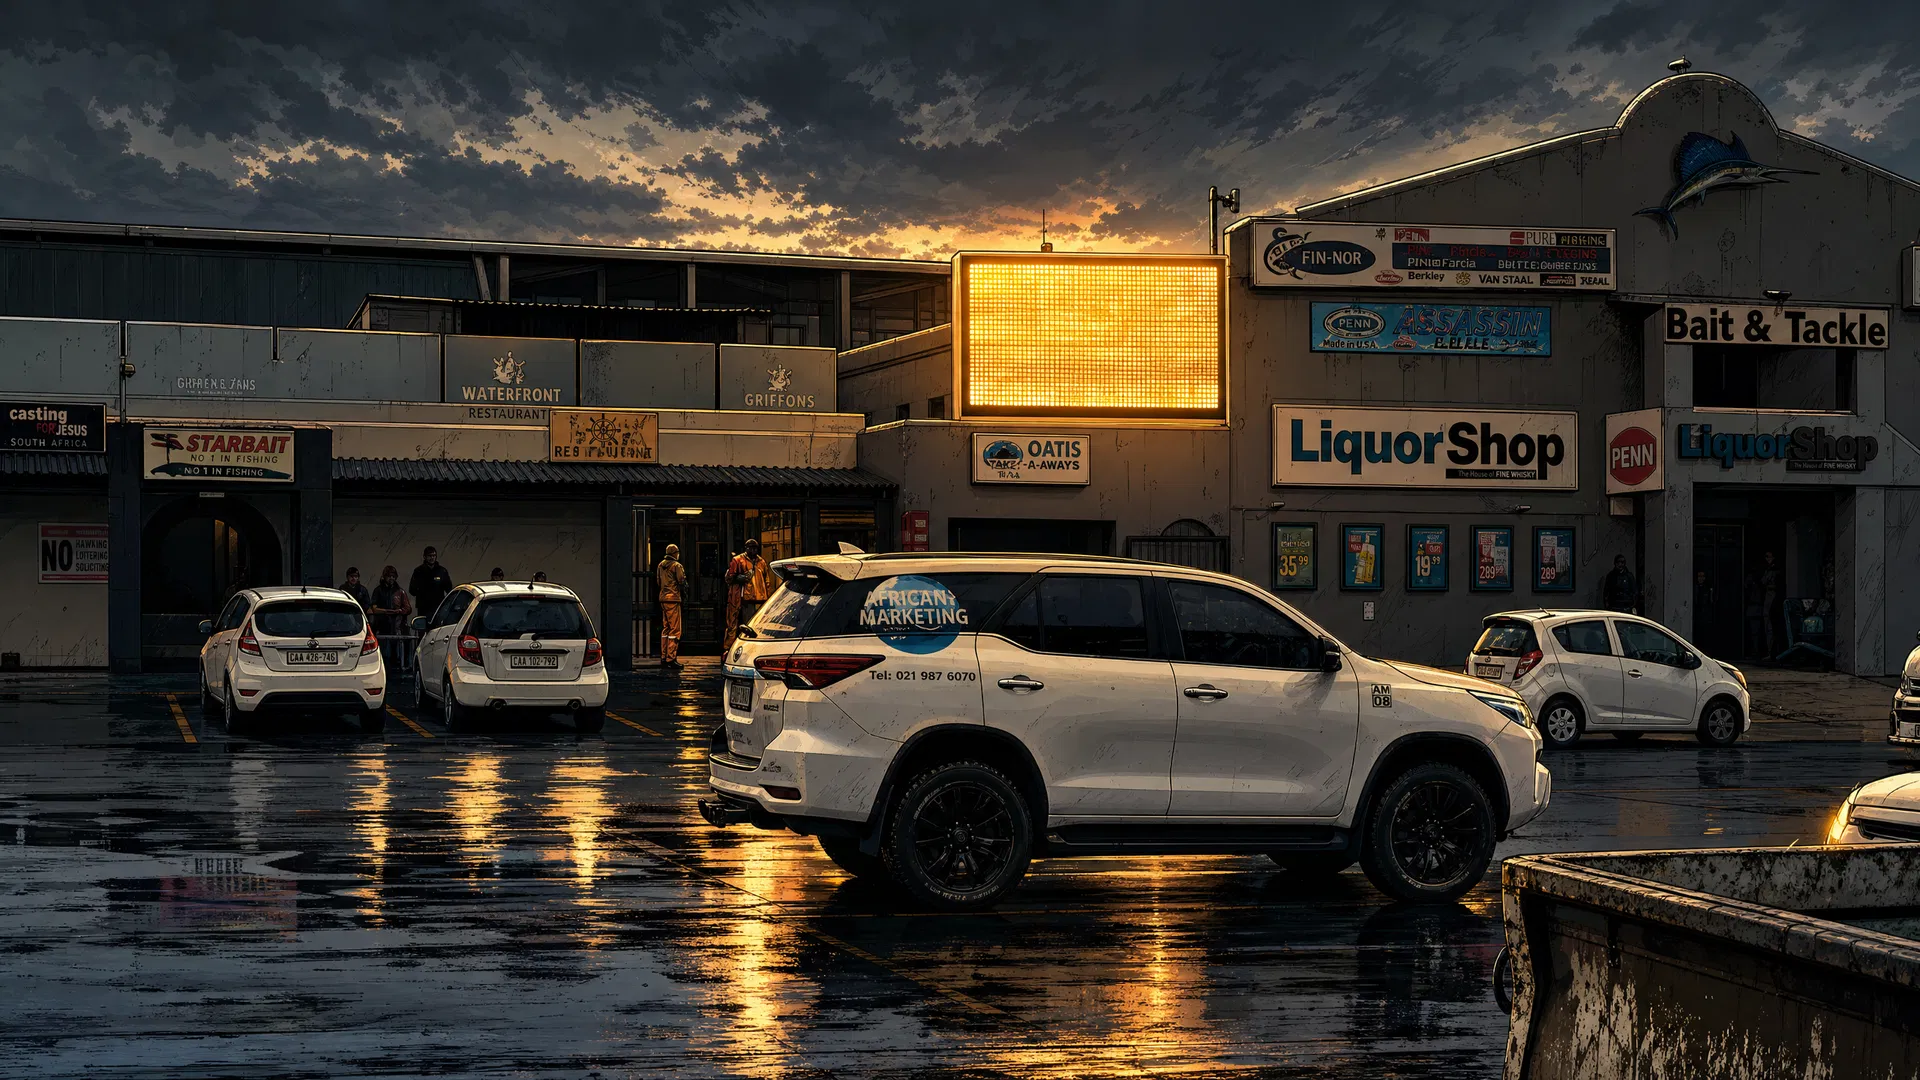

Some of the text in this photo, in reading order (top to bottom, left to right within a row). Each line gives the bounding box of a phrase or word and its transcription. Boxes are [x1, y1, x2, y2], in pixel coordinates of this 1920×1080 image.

[1526, 232, 1556, 245] PURE
[1302, 250, 1362, 265] FIN-NOR
[1408, 271, 1445, 282] Berkley
[1478, 274, 1500, 284] VAN
[1502, 275, 1534, 285] STAAL
[1339, 318, 1371, 329] PENN
[1393, 307, 1543, 337] ASSASSIN
[1667, 307, 1886, 346] Bait & Tackle
[1323, 339, 1345, 348] Made
[1347, 340, 1355, 348] in
[462, 386, 562, 402] WATERFRONT
[744, 393, 816, 408] GRIFFONS
[9, 406, 68, 424] casting
[469, 408, 547, 420] RESTAURANT
[36, 423, 88, 437] FOR JESUS
[10, 437, 88, 448] SOUTH AFRICA
[187, 434, 291, 453] STARBAIT
[1028, 440, 1081, 458] OATIS
[190, 454, 279, 464] NO 1 IN FISHING
[1611, 443, 1654, 470] PENN
[184, 466, 264, 476] NO 1 IN FISHING
[1458, 470, 1469, 478] The
[1496, 470, 1510, 478] FINE
[1511, 470, 1535, 479] WHISKY
[41, 539, 73, 572] NO
[1279, 555, 1309, 577] 35 99
[1415, 555, 1430, 577] 19
[1480, 565, 1496, 580] 289
[1541, 566, 1556, 580] 289
[860, 608, 969, 626] MARKETING
[290, 652, 335, 662] CAA 426-746
[513, 656, 556, 667] CAA 102-792
[869, 670, 976, 681] Tel: 021 987 6070
[1373, 685, 1390, 694] AM
[1374, 696, 1390, 706] 08
